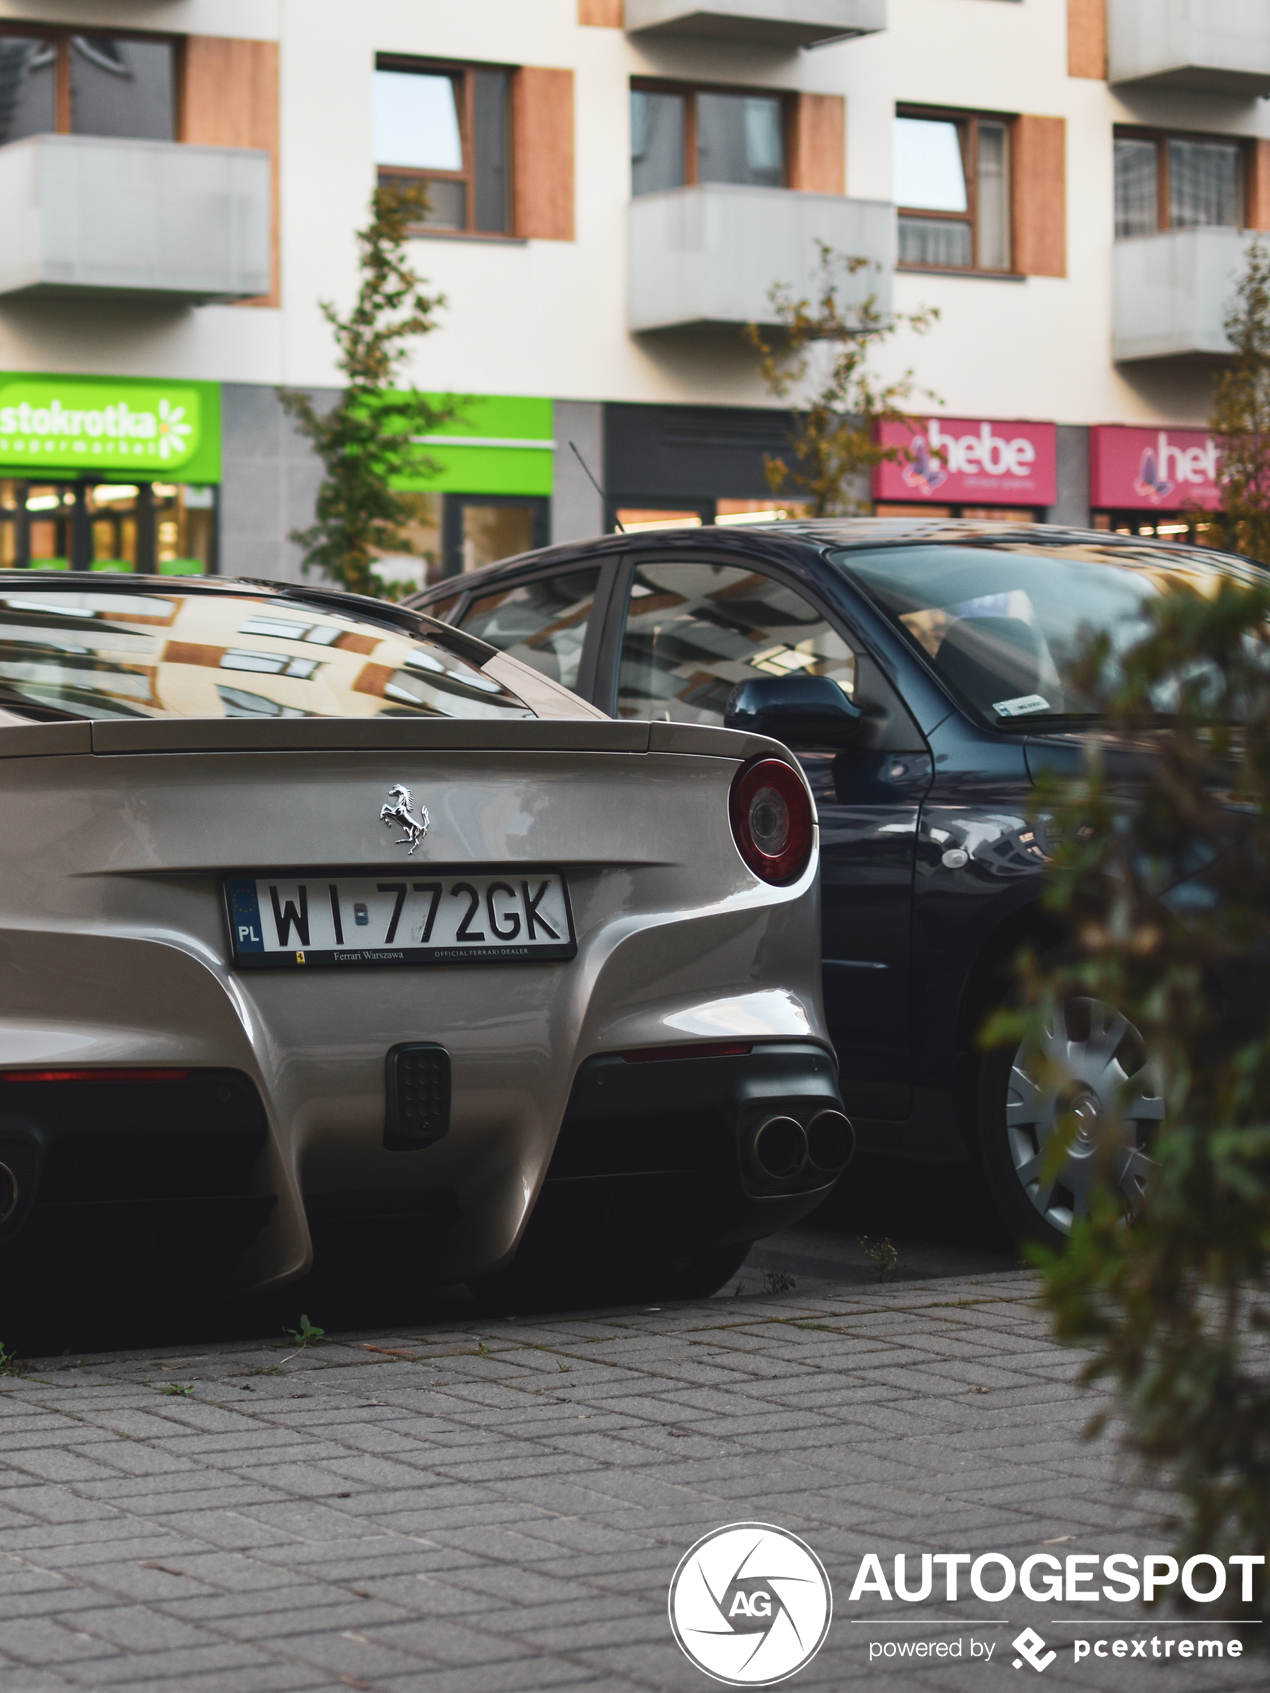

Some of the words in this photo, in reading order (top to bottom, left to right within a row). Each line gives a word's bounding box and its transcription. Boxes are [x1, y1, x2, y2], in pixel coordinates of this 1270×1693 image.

[0, 399, 156, 439] stokrotka
[929, 420, 1036, 476] hebe
[238, 925, 260, 942] PL
[268, 884, 345, 947] WI
[376, 880, 561, 944] 772GK
[334, 952, 361, 961] Ferrari
[362, 951, 404, 961] Warszawa
